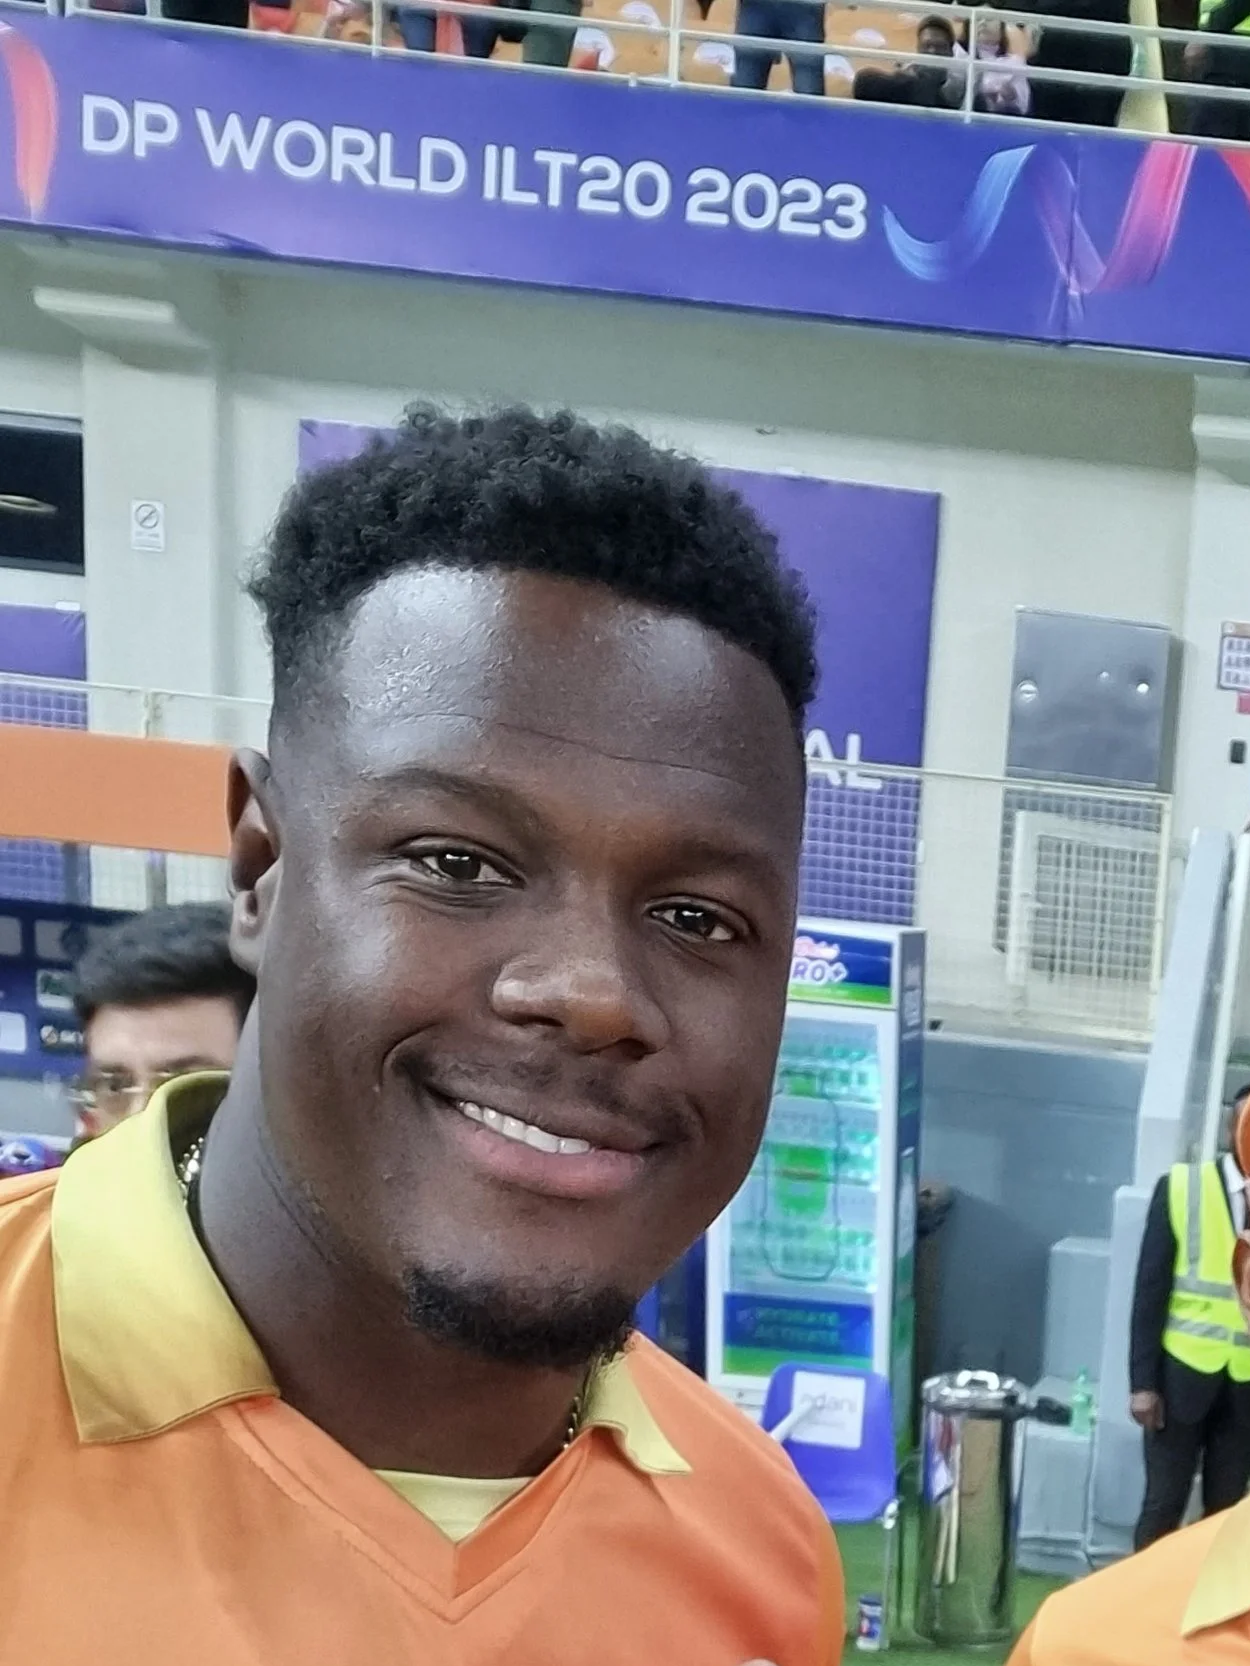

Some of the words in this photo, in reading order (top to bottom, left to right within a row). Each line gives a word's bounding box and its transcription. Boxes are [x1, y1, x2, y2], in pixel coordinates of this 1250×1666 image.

[82, 95, 179, 157] DP
[196, 107, 467, 193] WORLD
[483, 143, 670, 218] ILT20
[685, 167, 868, 241] 2023
